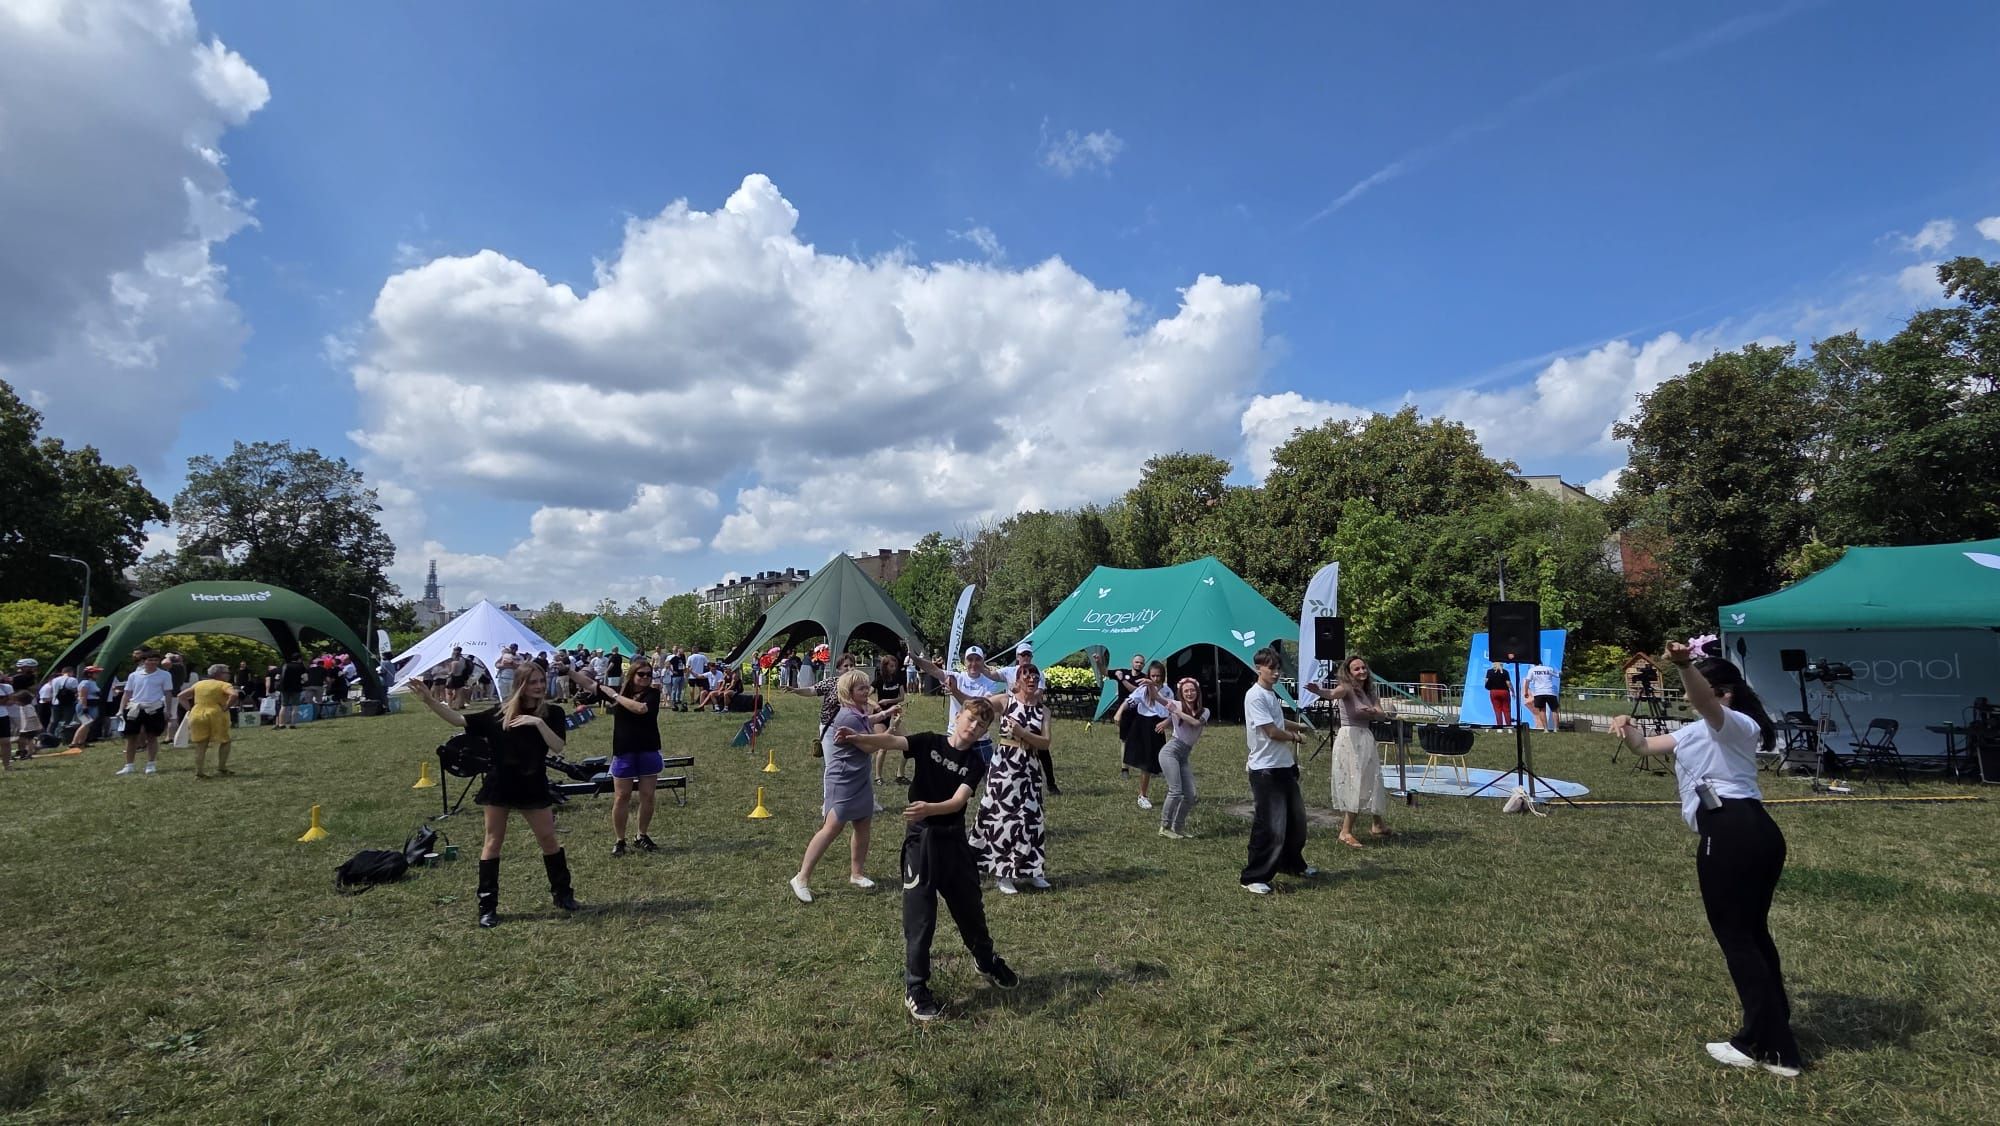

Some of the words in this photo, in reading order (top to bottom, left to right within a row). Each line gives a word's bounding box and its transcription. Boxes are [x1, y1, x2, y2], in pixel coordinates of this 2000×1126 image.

[191, 592, 267, 601] Herbalife
[1083, 609, 1162, 626] longevity
[930, 750, 942, 763] GO
